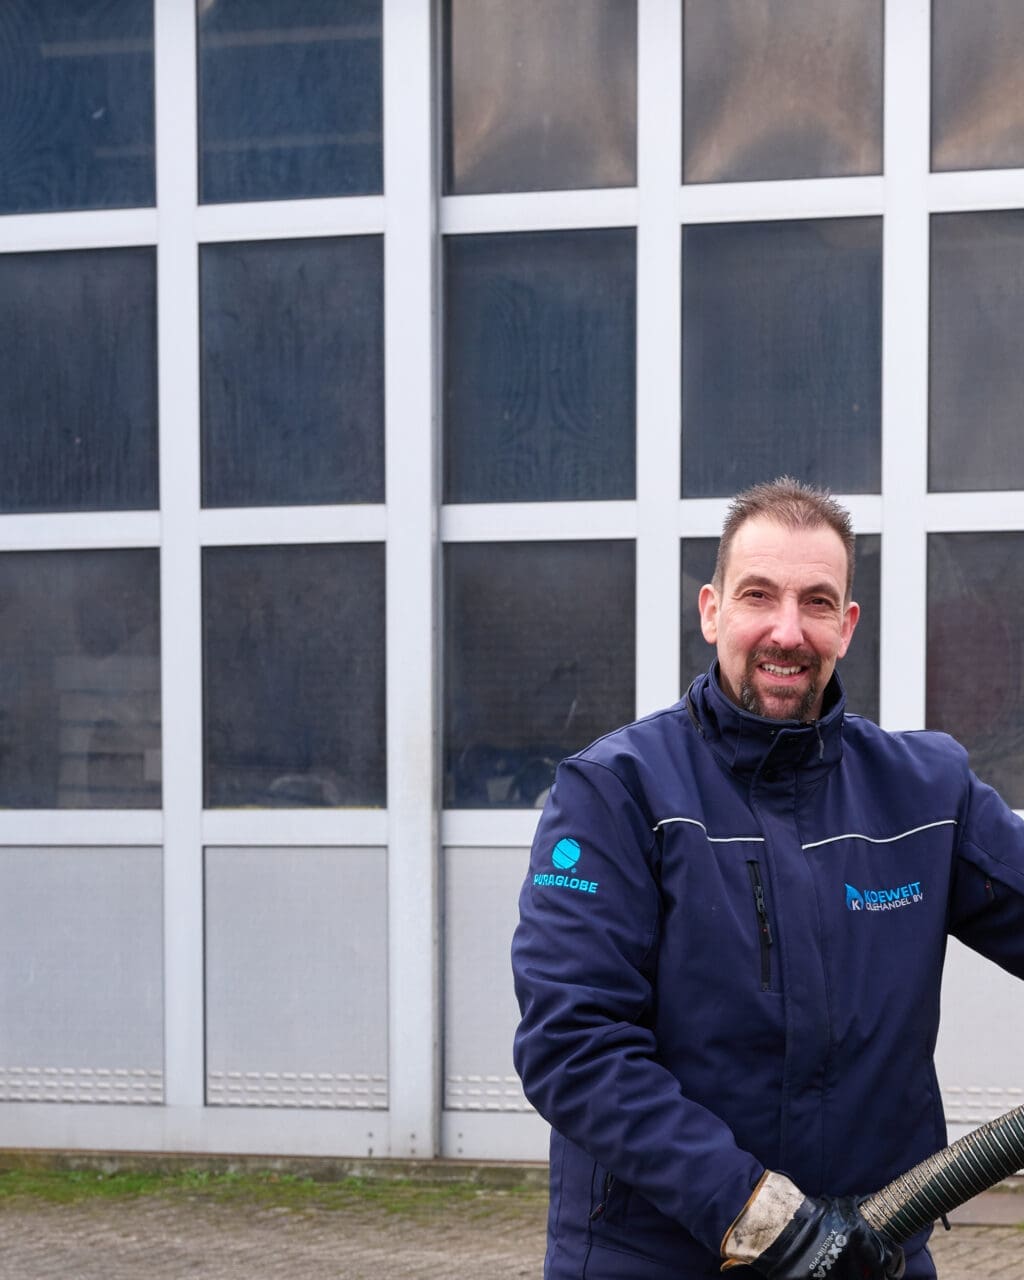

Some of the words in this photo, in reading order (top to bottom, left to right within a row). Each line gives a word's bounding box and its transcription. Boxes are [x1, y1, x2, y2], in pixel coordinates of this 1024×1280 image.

[533, 873, 599, 894] PURAGLOBE
[863, 882, 920, 904] KOEWEIT
[851, 900, 862, 911] K
[912, 892, 923, 903] BV
[812, 1234, 848, 1278] OXXA
